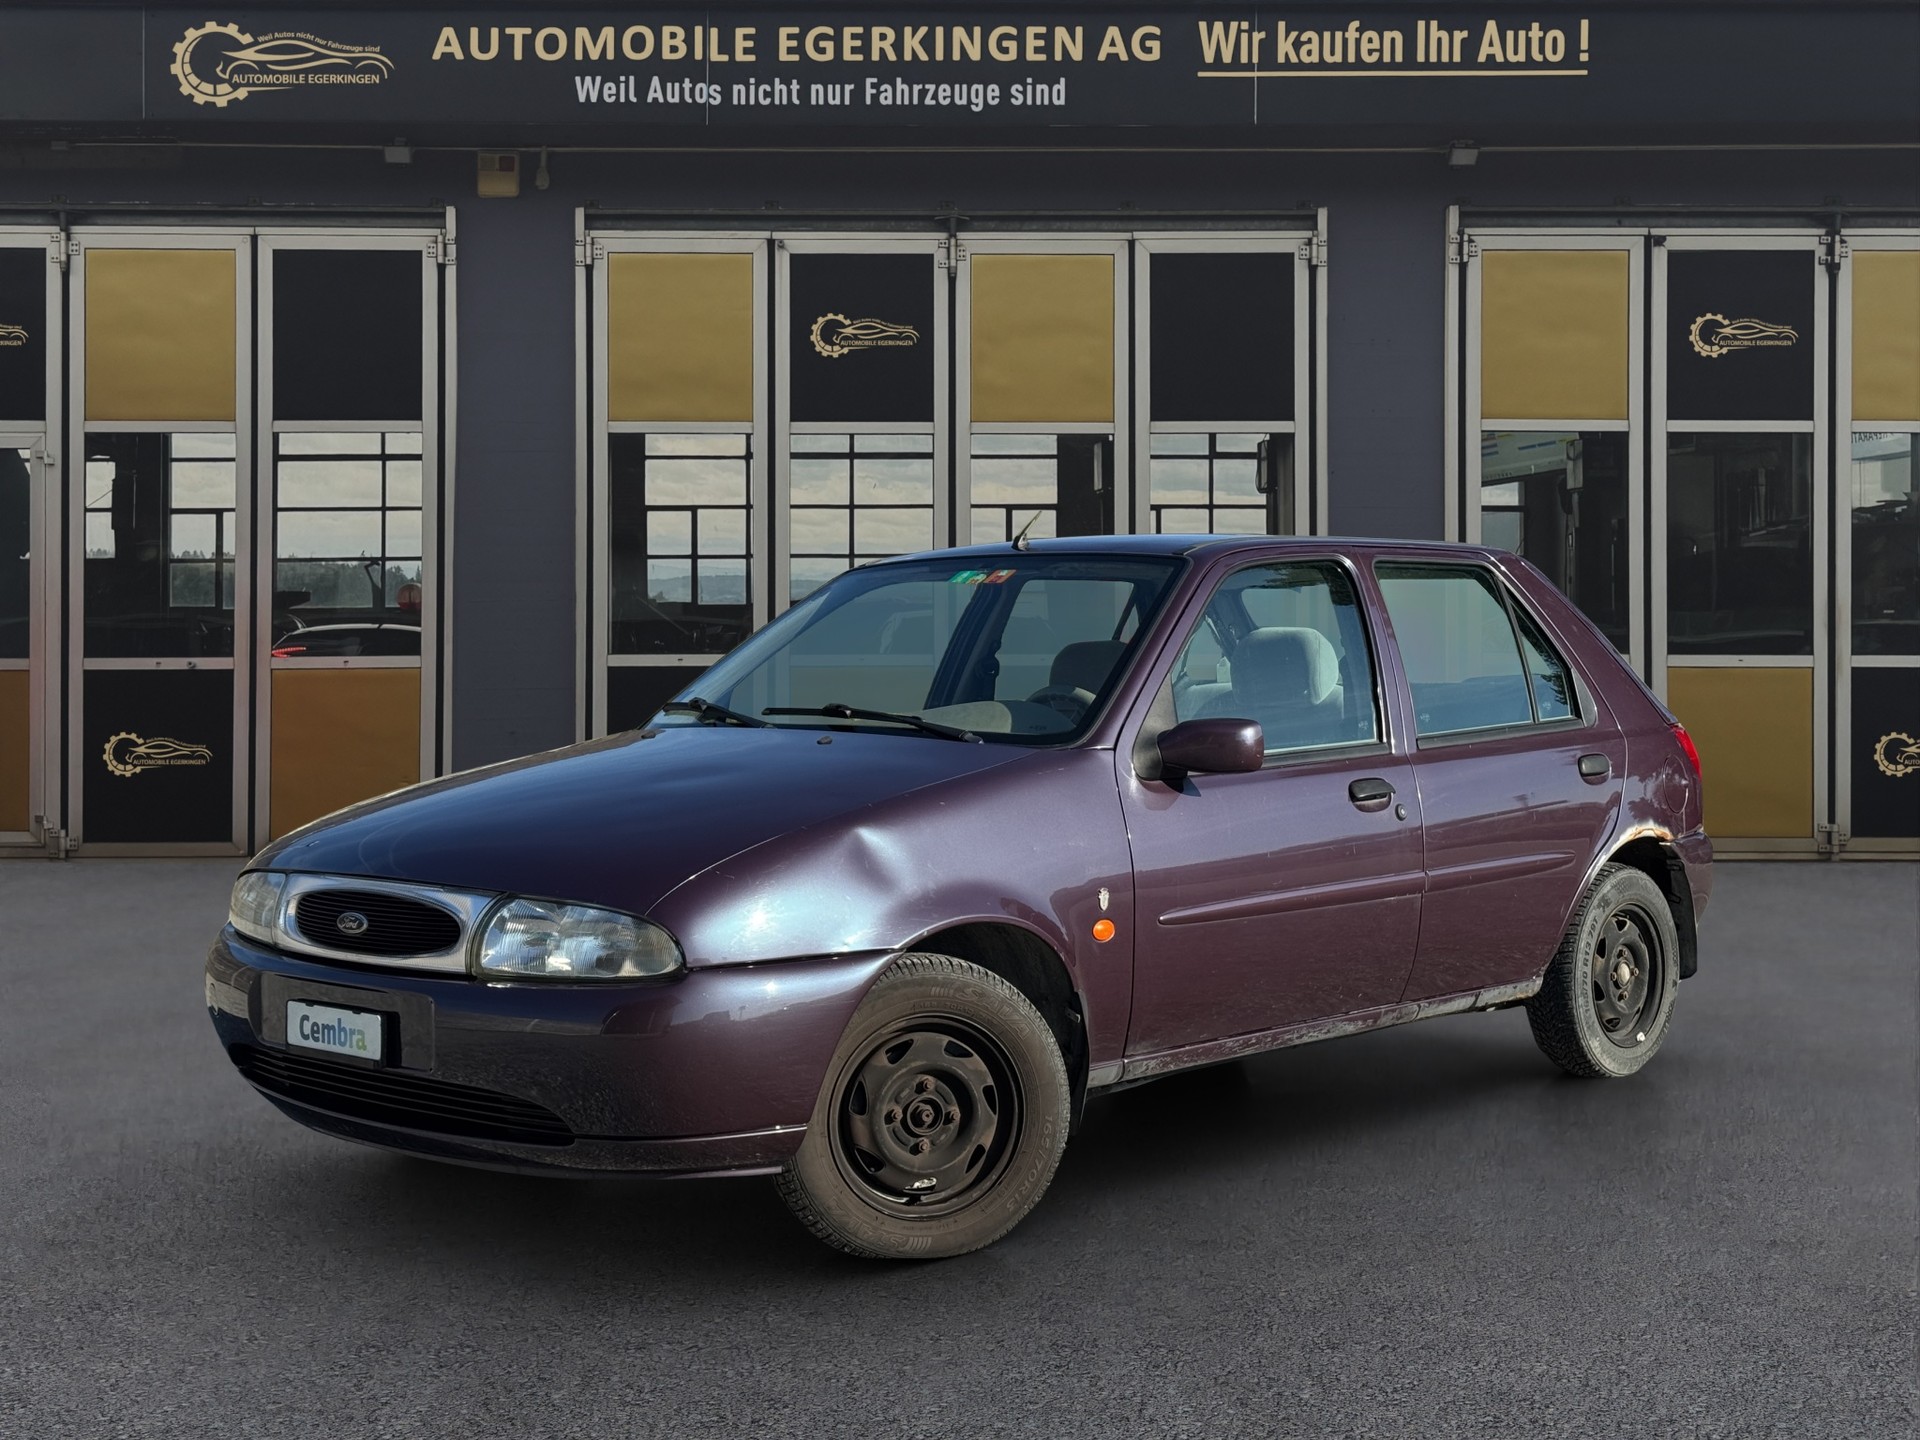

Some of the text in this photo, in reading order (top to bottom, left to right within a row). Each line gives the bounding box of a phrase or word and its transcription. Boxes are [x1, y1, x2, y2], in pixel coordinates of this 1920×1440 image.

[257, 33, 273, 43] Weil
[296, 32, 315, 41] nicht
[314, 37, 327, 45] nur
[327, 40, 364, 53] Fahrzeuge
[364, 45, 381, 53] sind
[432, 25, 1162, 63] AUTOMOBILE EGERKINGEN AG
[1198, 18, 1589, 64] Wir kaufen Ihr Auto !
[232, 74, 380, 85] AUTOMOBILE EGERKINGEN
[575, 76, 1066, 113] Weil Autos nicht nur Fahrzeuge sind
[299, 1014, 367, 1051] Cembra
